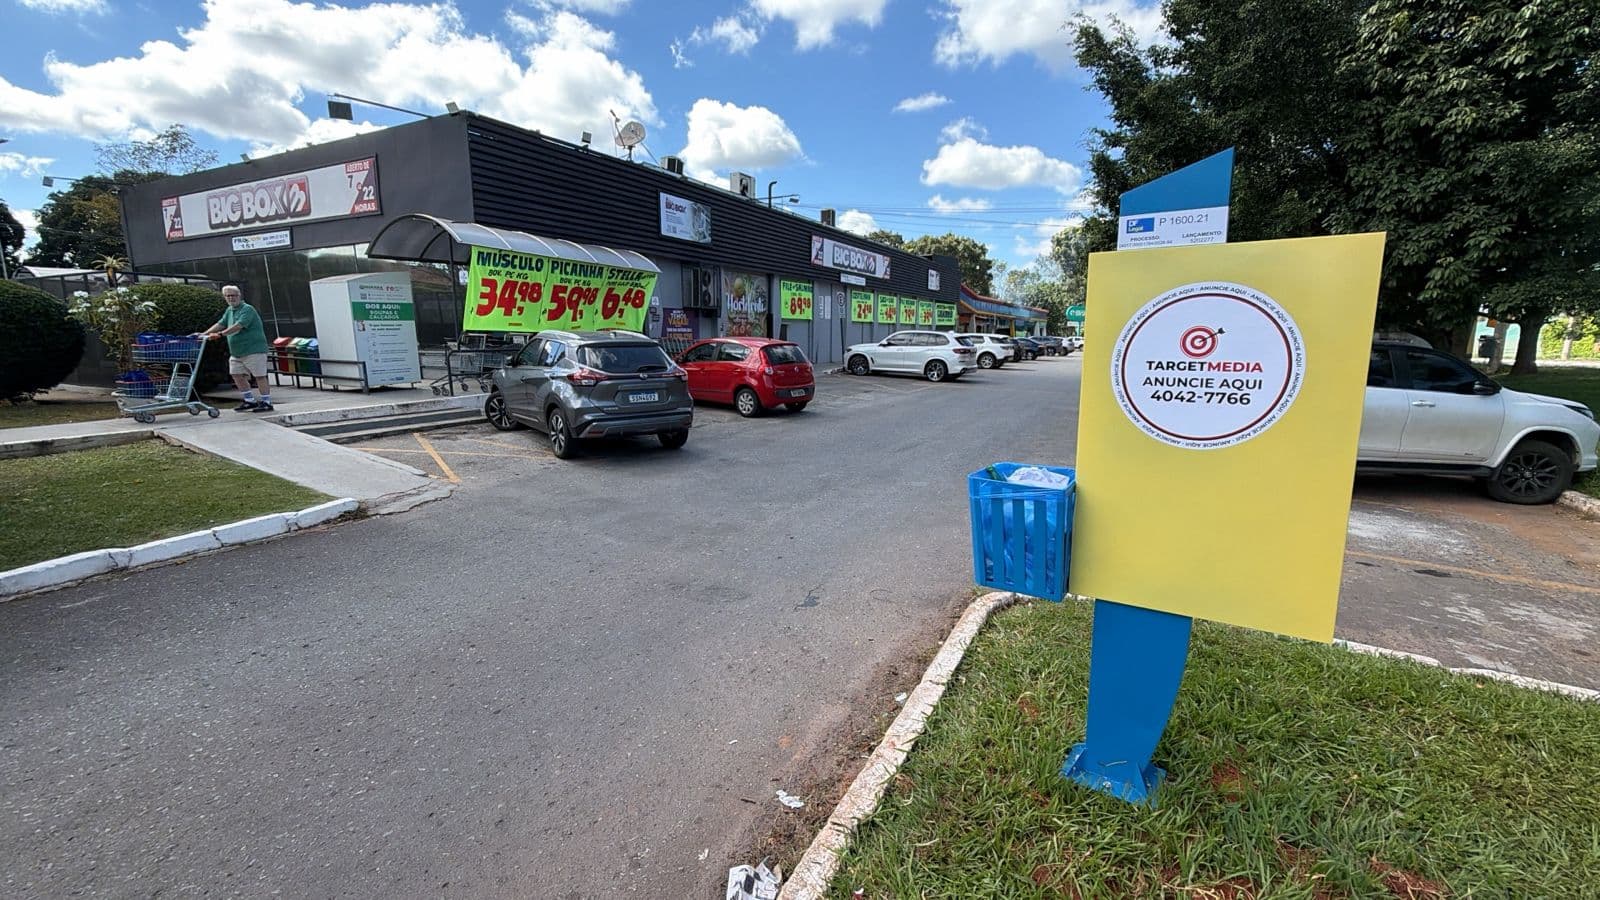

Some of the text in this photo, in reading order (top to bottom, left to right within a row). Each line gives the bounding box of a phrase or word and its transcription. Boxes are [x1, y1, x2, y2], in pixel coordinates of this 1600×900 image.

[363, 185, 375, 200] 22
[209, 184, 286, 225] BIG BOX
[1159, 213, 1209, 226] P 1600.21
[1182, 230, 1222, 239] LANÇAMENTO
[834, 246, 850, 266] BIG
[850, 252, 867, 271] BOX
[550, 260, 604, 279] PICANHA
[608, 267, 642, 283] STELLA
[476, 277, 543, 317] 34,98
[602, 287, 646, 320] 6,48
[1146, 360, 1263, 373] TARGETMEDIA
[1142, 376, 1263, 391] ANUNCIE AQUI
[1150, 390, 1251, 405] 4042-7766
